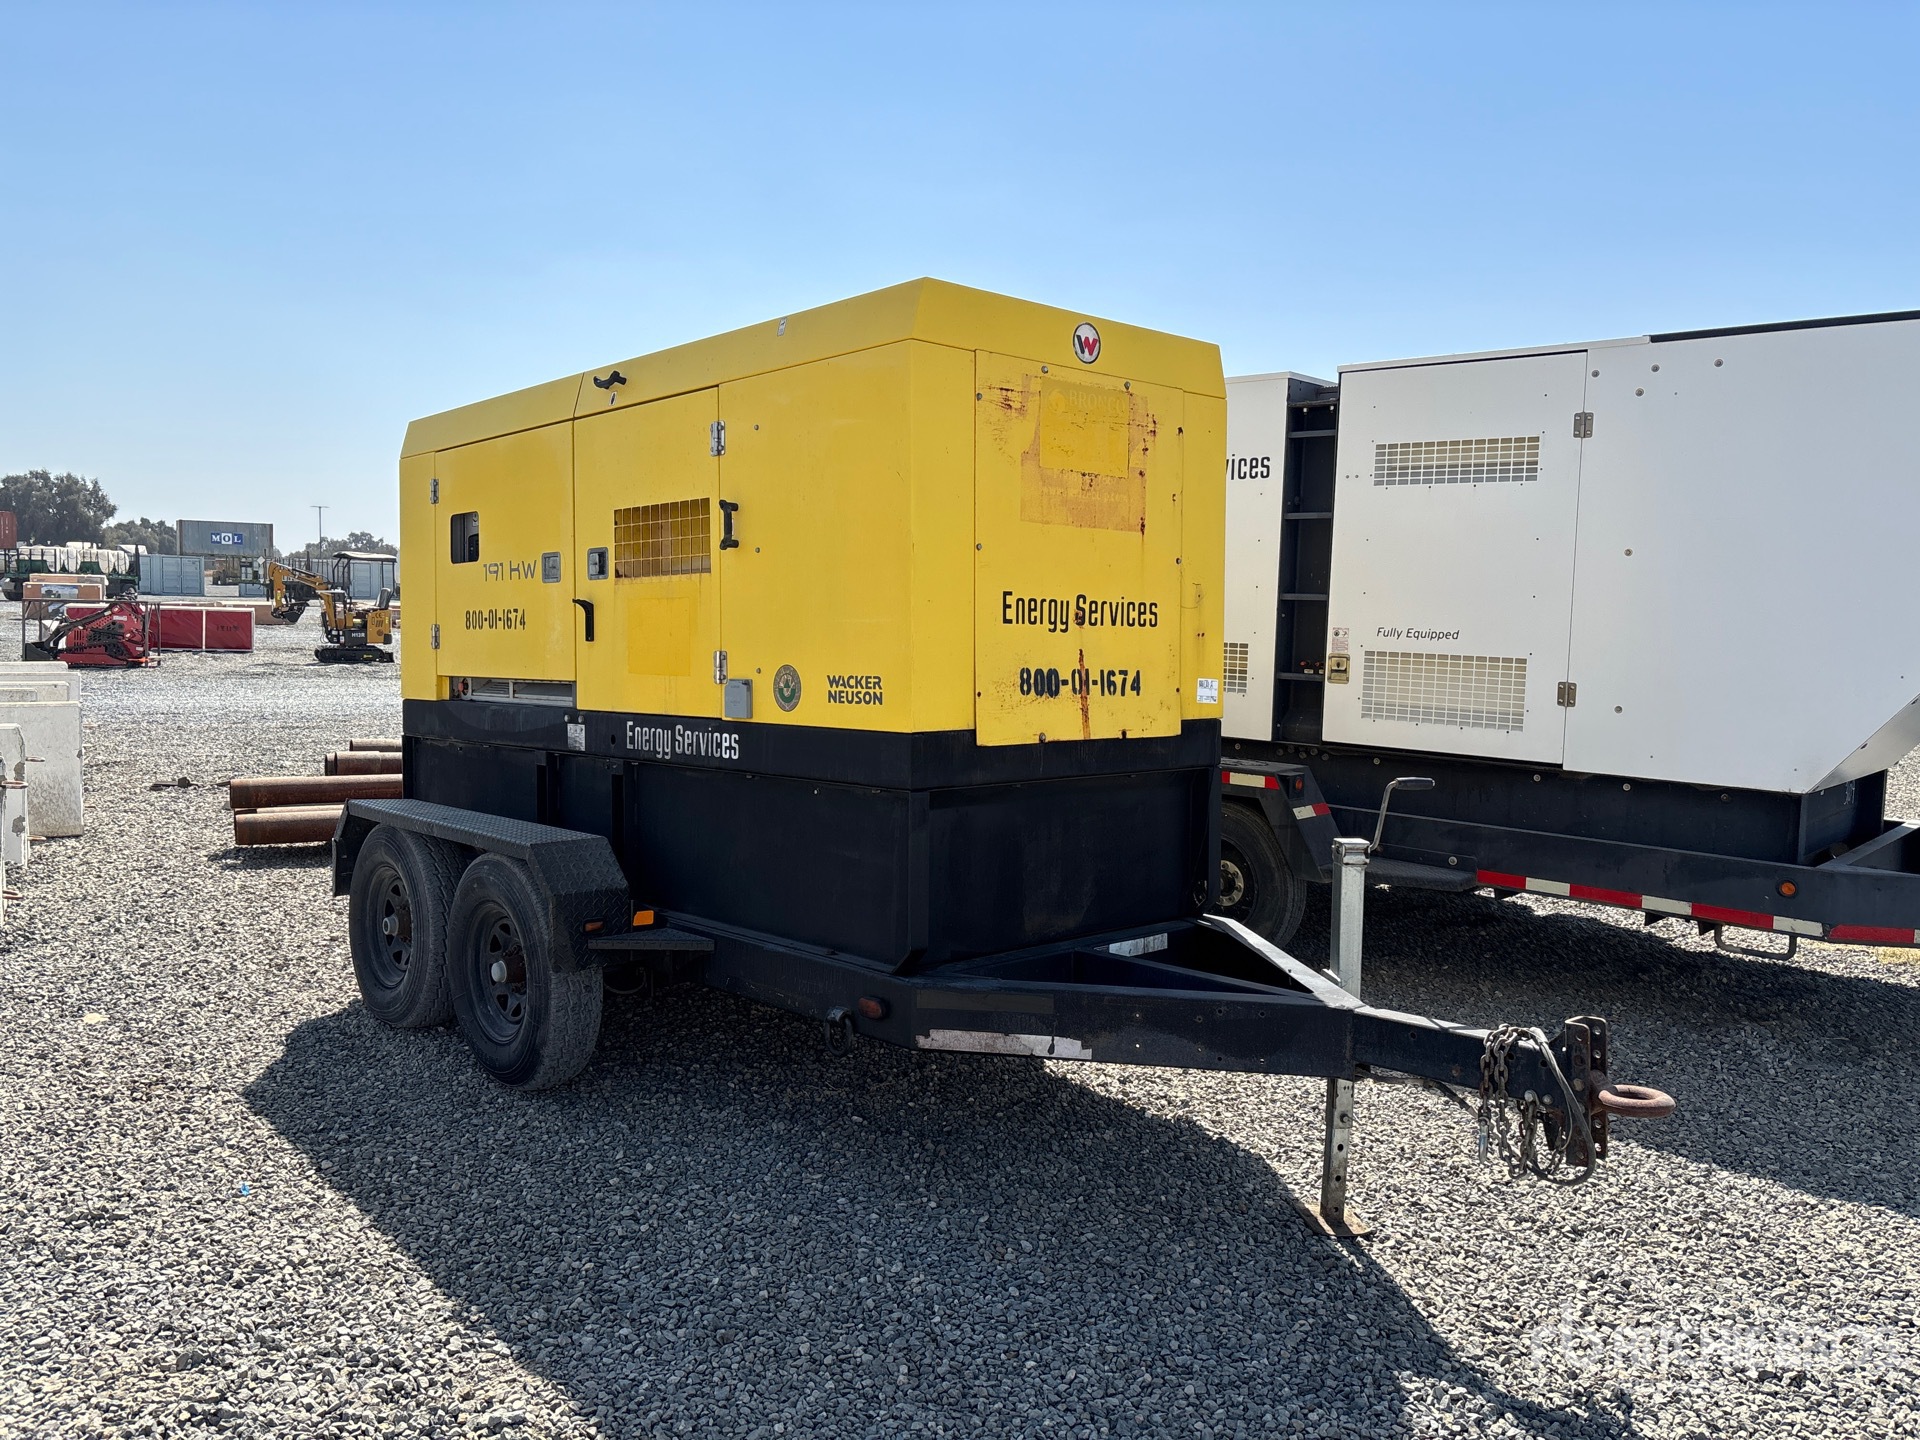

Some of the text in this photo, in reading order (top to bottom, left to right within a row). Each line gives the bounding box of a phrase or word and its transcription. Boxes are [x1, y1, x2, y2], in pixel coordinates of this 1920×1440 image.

[483, 562, 504, 582] 191
[465, 608, 526, 631] 800-01-1674
[1002, 590, 1158, 633] Energy Services
[1376, 626, 1460, 641] Fully Equipped
[826, 674, 883, 690] WACKER
[1019, 667, 1141, 698] 800-01-1674
[827, 689, 883, 706] NEUSON
[626, 720, 672, 760] Energy
[675, 724, 739, 760] Services
